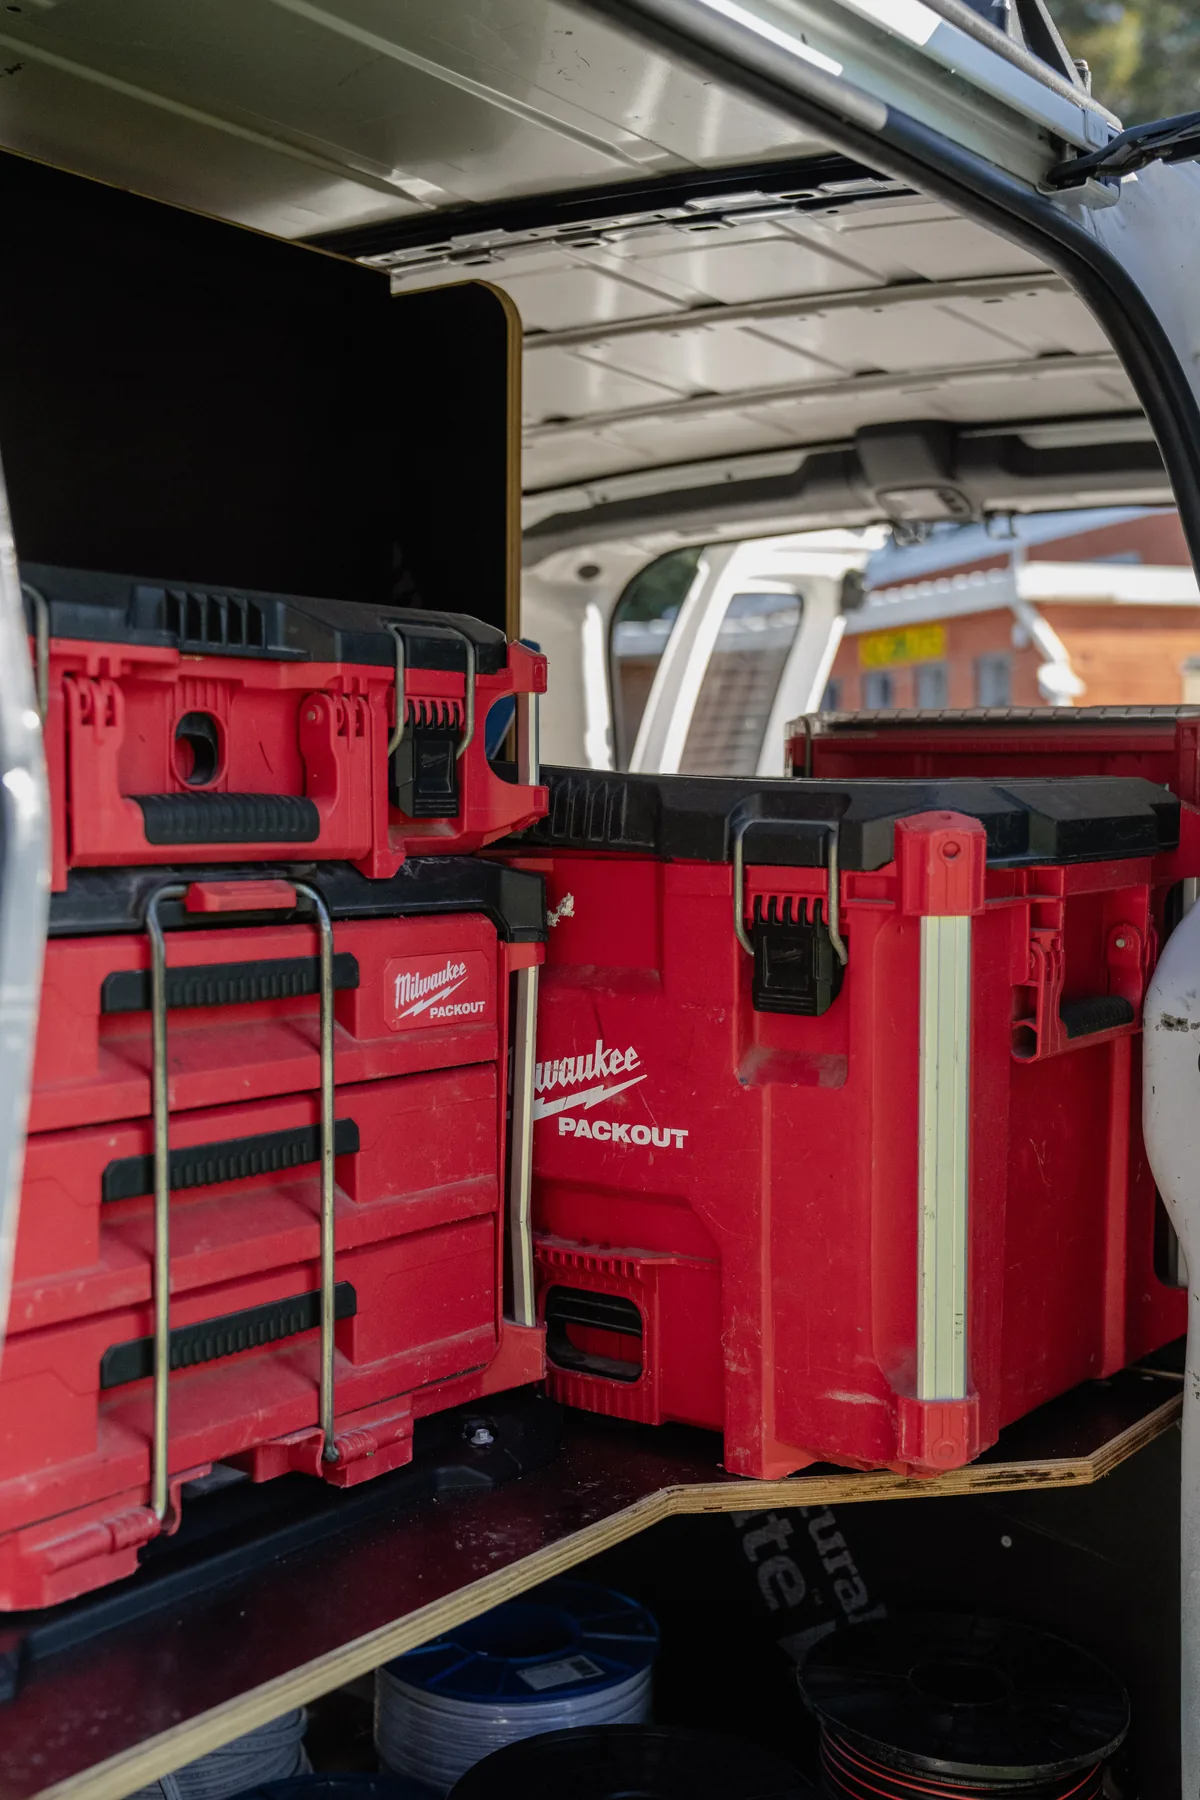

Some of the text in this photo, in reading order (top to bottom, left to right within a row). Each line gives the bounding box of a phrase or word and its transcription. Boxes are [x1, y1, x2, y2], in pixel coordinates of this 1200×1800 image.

[394, 960, 467, 1009] Milwaukee
[430, 1001, 486, 1019] PACKOUT
[533, 1039, 641, 1093] waukee
[558, 1116, 689, 1149] PACKOUT
[798, 1505, 888, 1624] ural
